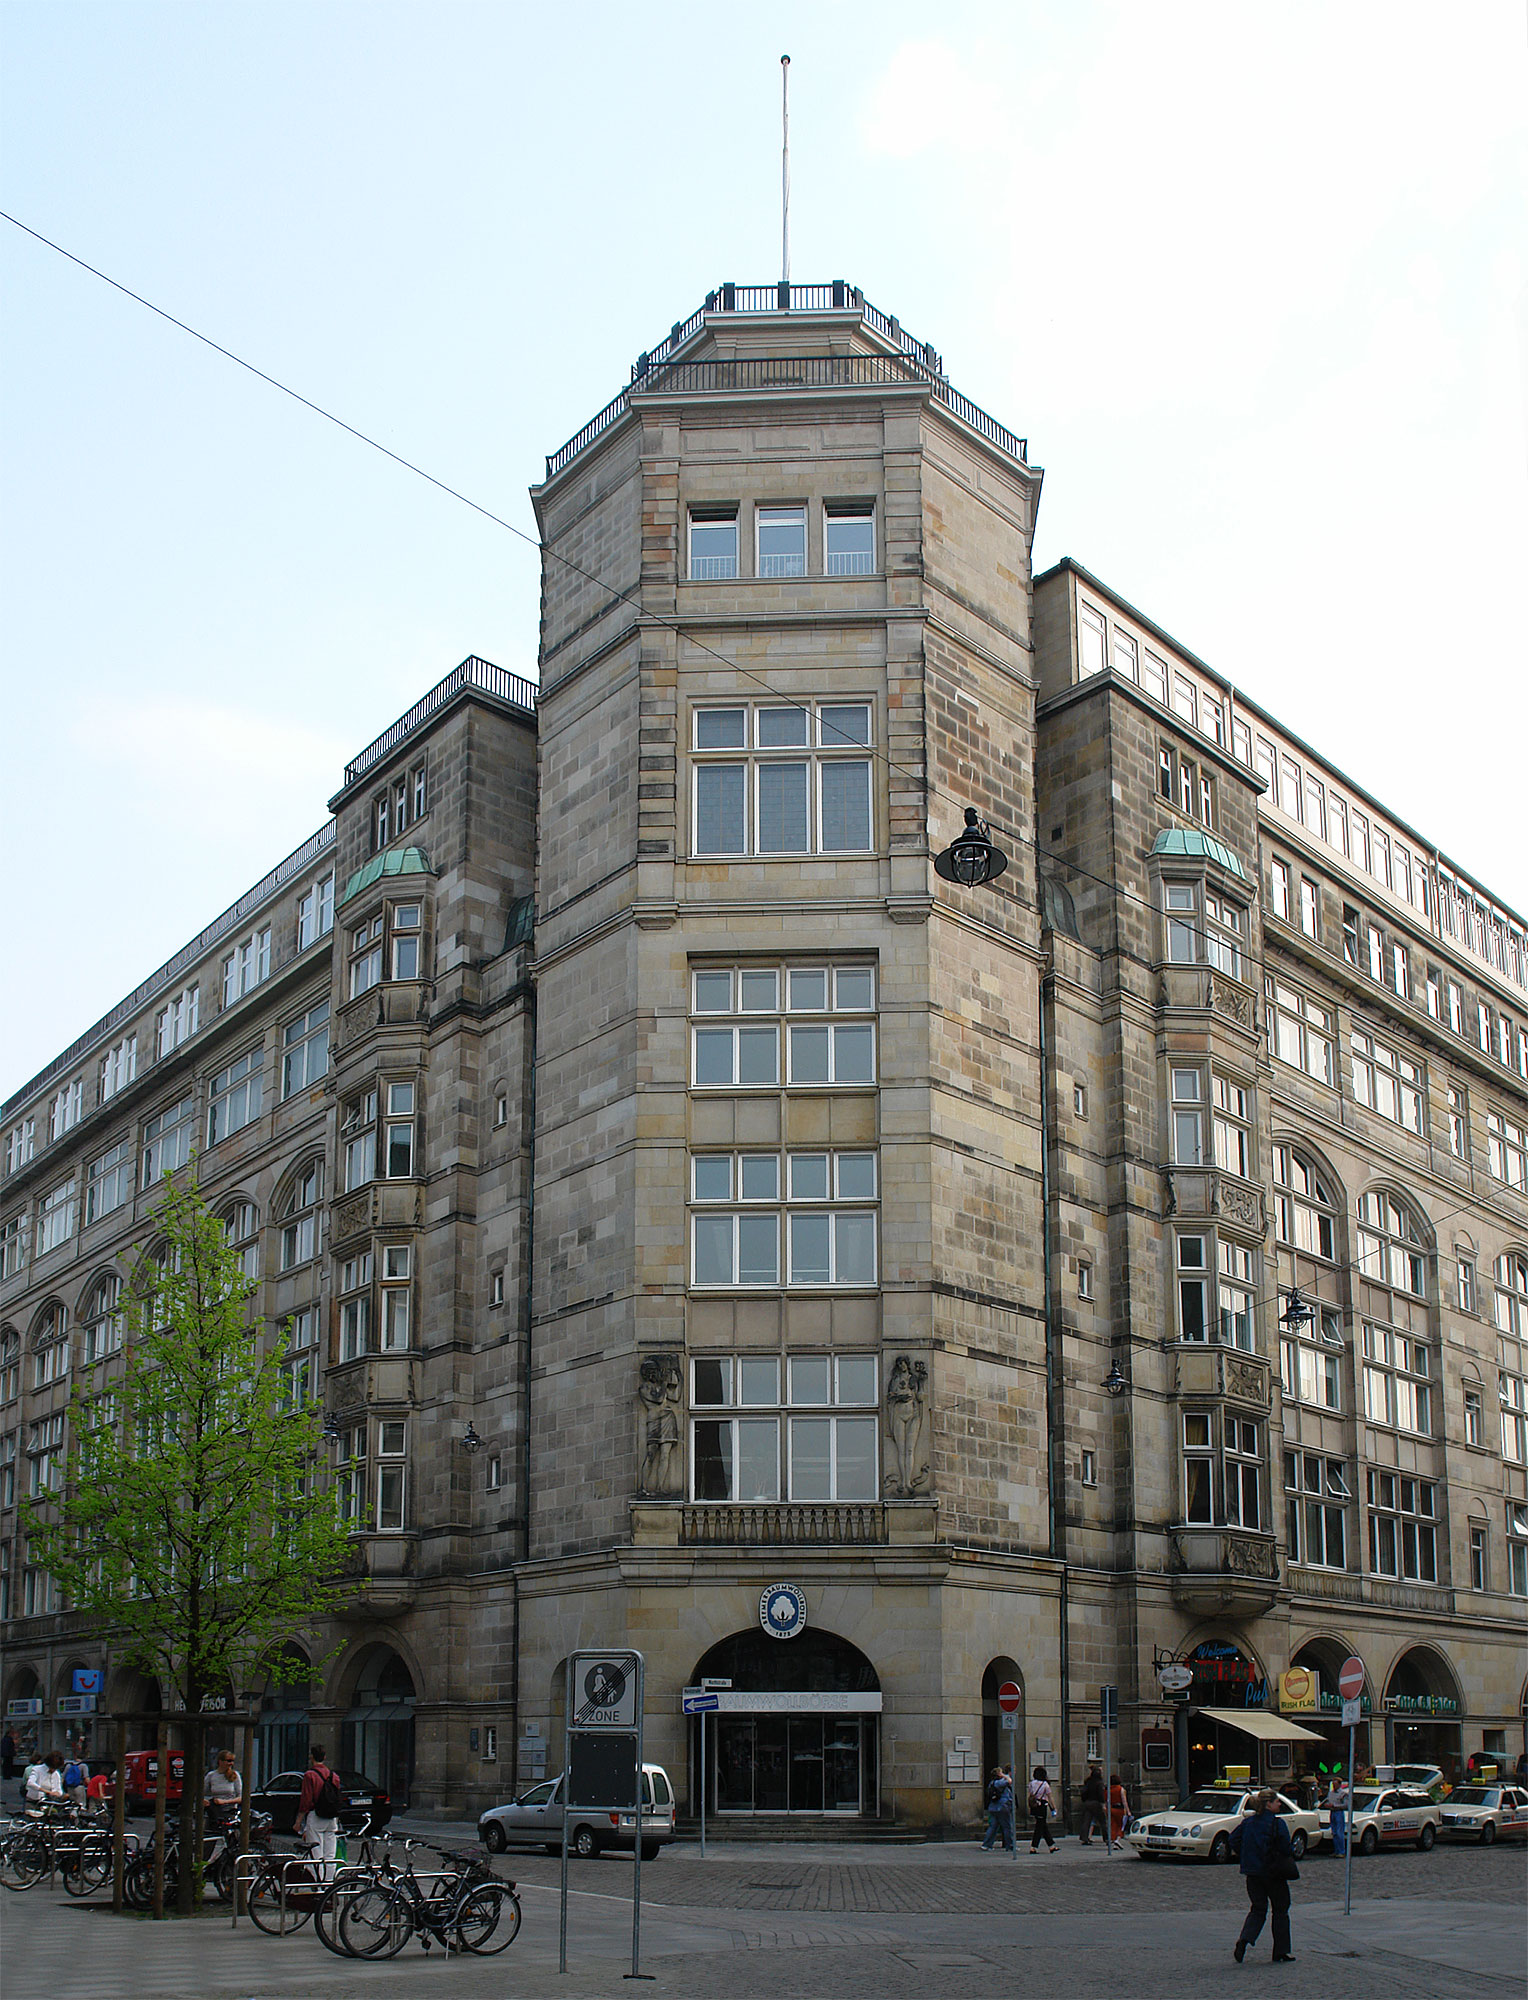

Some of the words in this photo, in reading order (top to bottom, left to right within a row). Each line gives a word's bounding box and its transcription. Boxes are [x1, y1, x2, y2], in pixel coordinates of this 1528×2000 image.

[1197, 1643, 1239, 1658] Welcome
[1222, 1662, 1249, 1682] FLAG
[1281, 1701, 1298, 1709] IRISH
[1299, 1700, 1316, 1708] FLAG
[588, 1710, 620, 1722] ZONE
